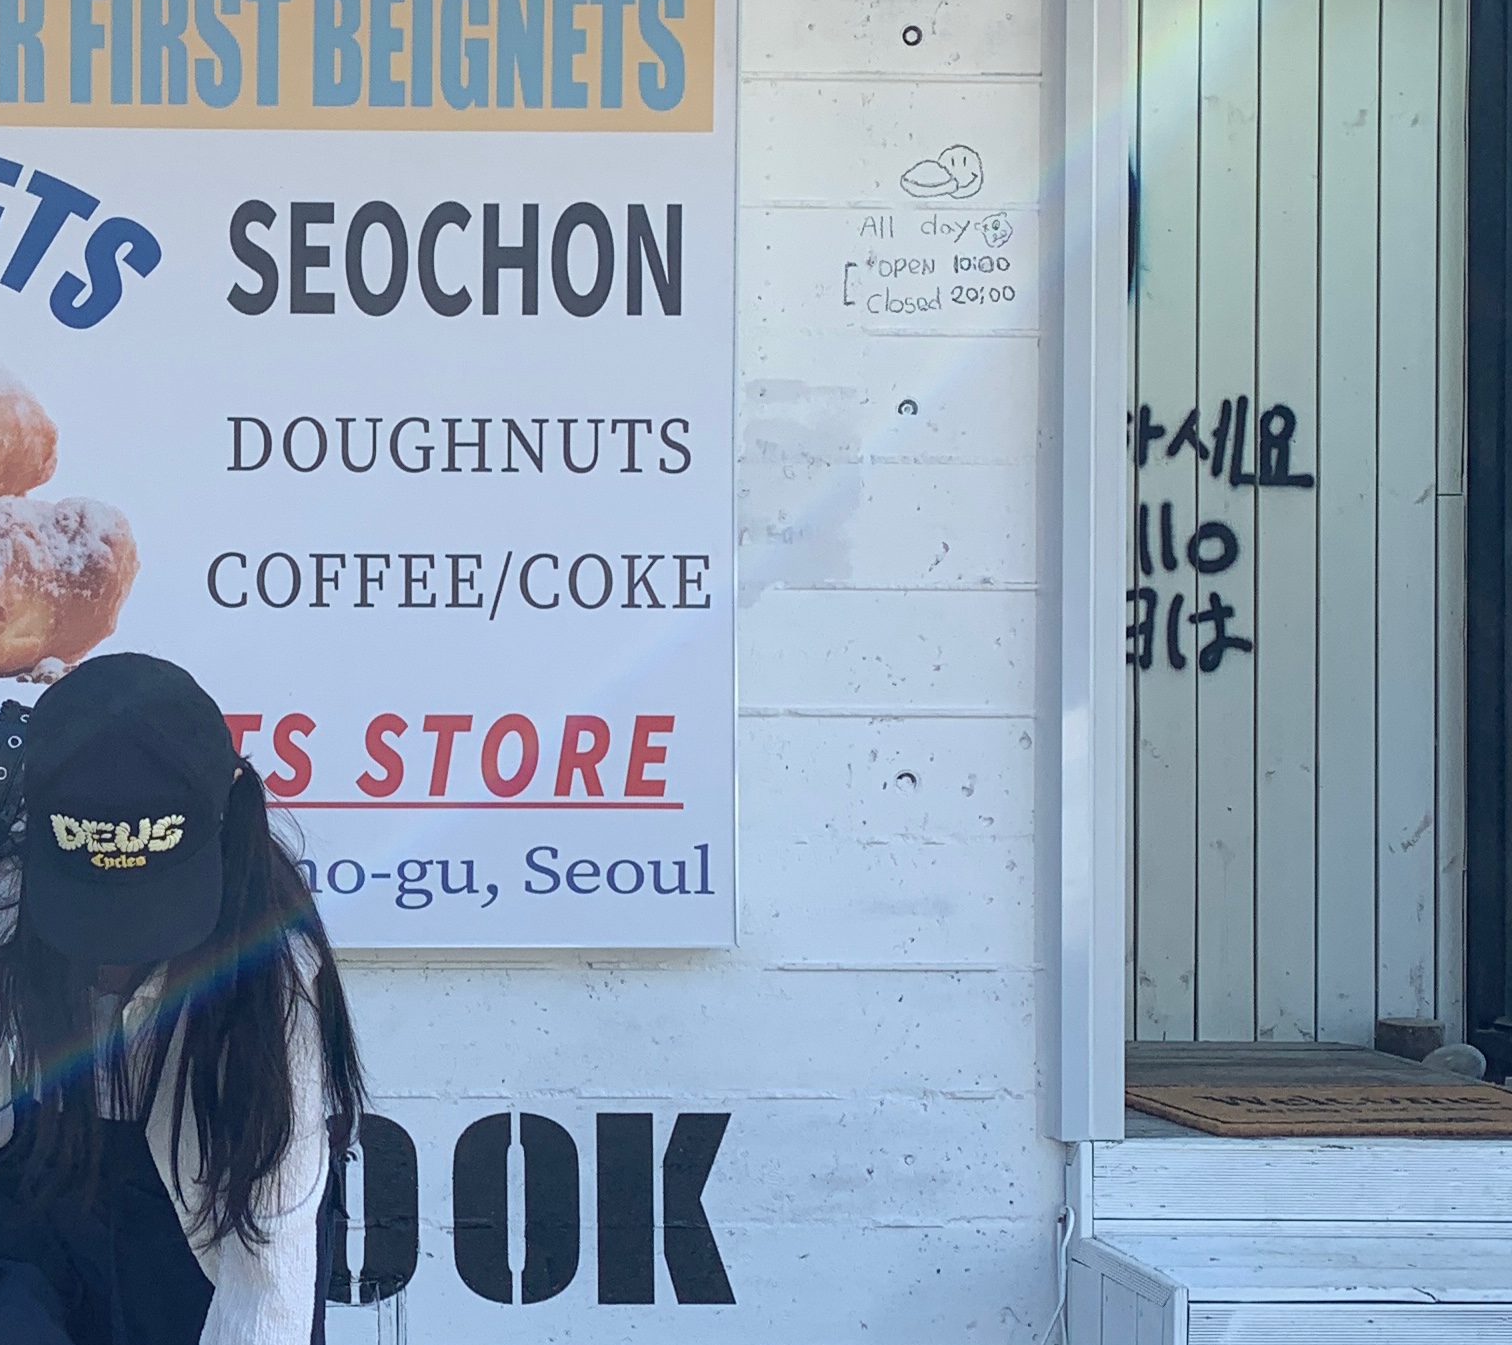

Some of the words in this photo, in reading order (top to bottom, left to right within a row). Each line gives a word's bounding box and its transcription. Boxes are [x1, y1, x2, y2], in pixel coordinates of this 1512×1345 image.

[859, 215, 894, 239] All
[920, 213, 971, 244] day
[226, 199, 683, 318] SEOCHON
[953, 254, 1011, 274] 10:00
[866, 285, 943, 314] Closed
[226, 415, 693, 475] DOUGHNUTS
[206, 550, 712, 622] COFFEE/COKE
[355, 712, 676, 799] STORE
[49, 813, 186, 853] DEUS
[523, 842, 716, 896] Seoul
